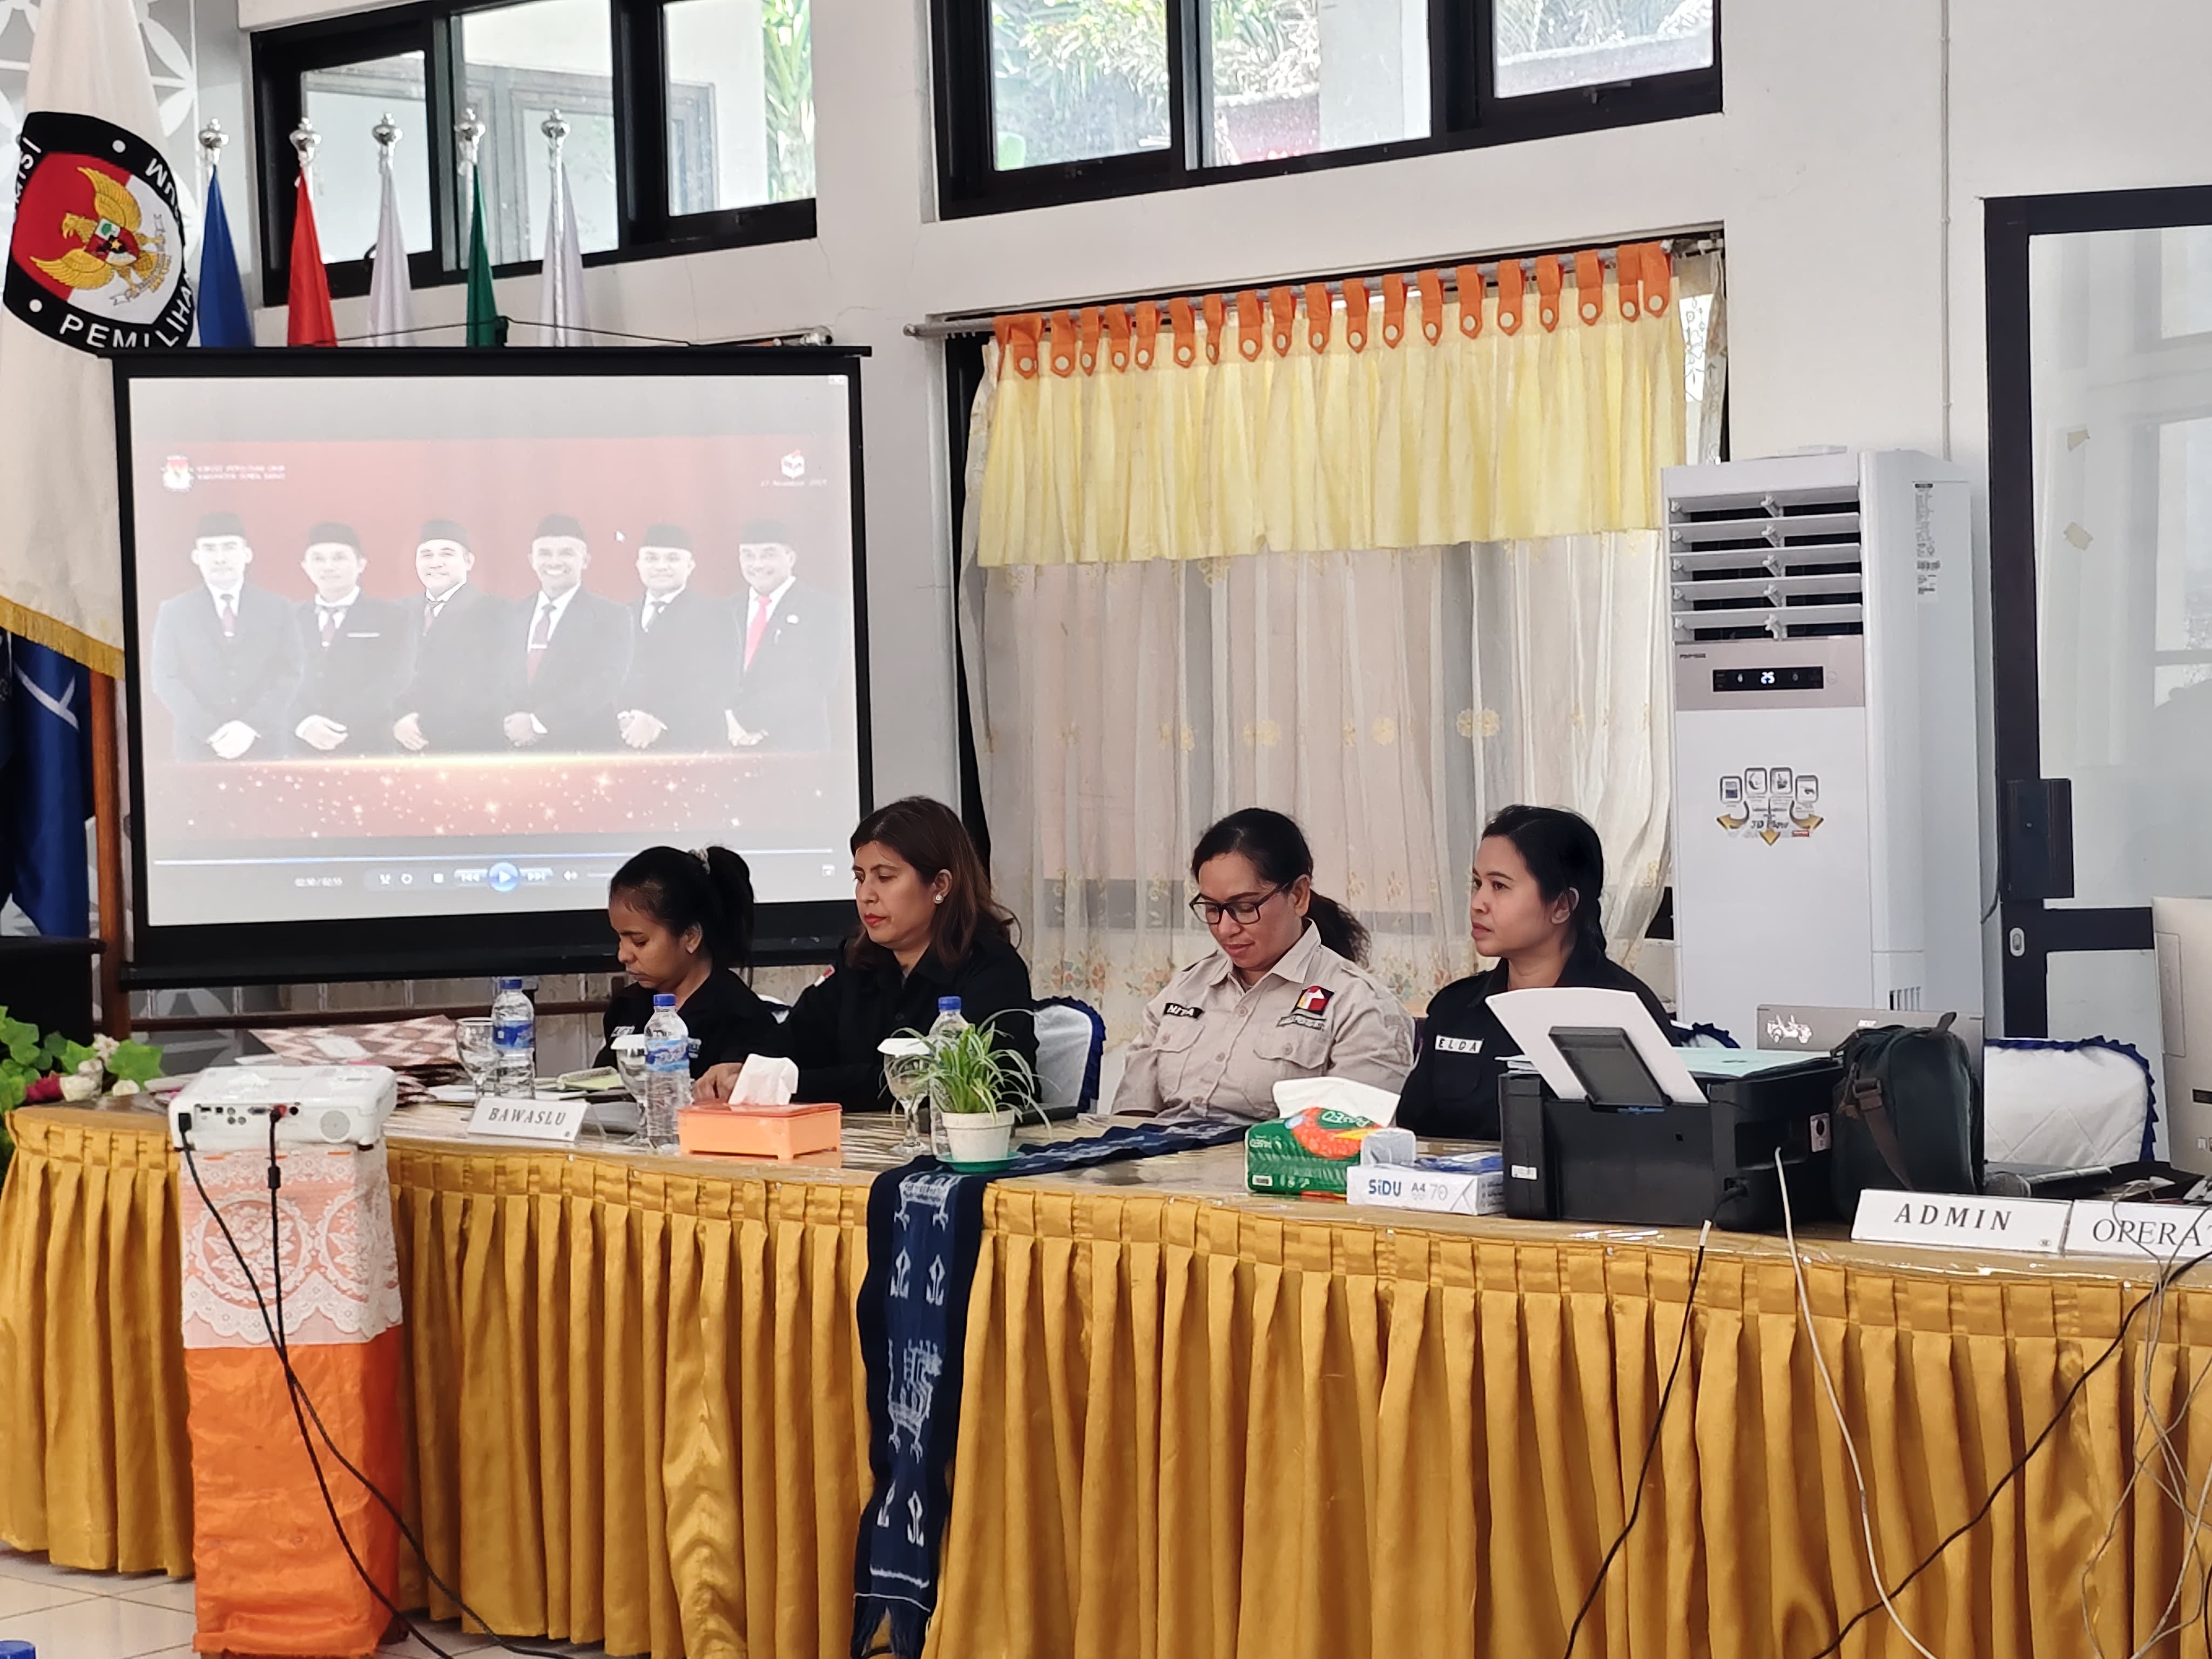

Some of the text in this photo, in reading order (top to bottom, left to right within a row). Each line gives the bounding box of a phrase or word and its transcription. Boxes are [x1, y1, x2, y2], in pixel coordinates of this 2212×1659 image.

[1760, 671, 1775, 684] 25
[488, 1108, 566, 1126] BAWASLU
[1411, 1182, 1426, 1192] A4
[1894, 1203, 2012, 1231] ADMIN
